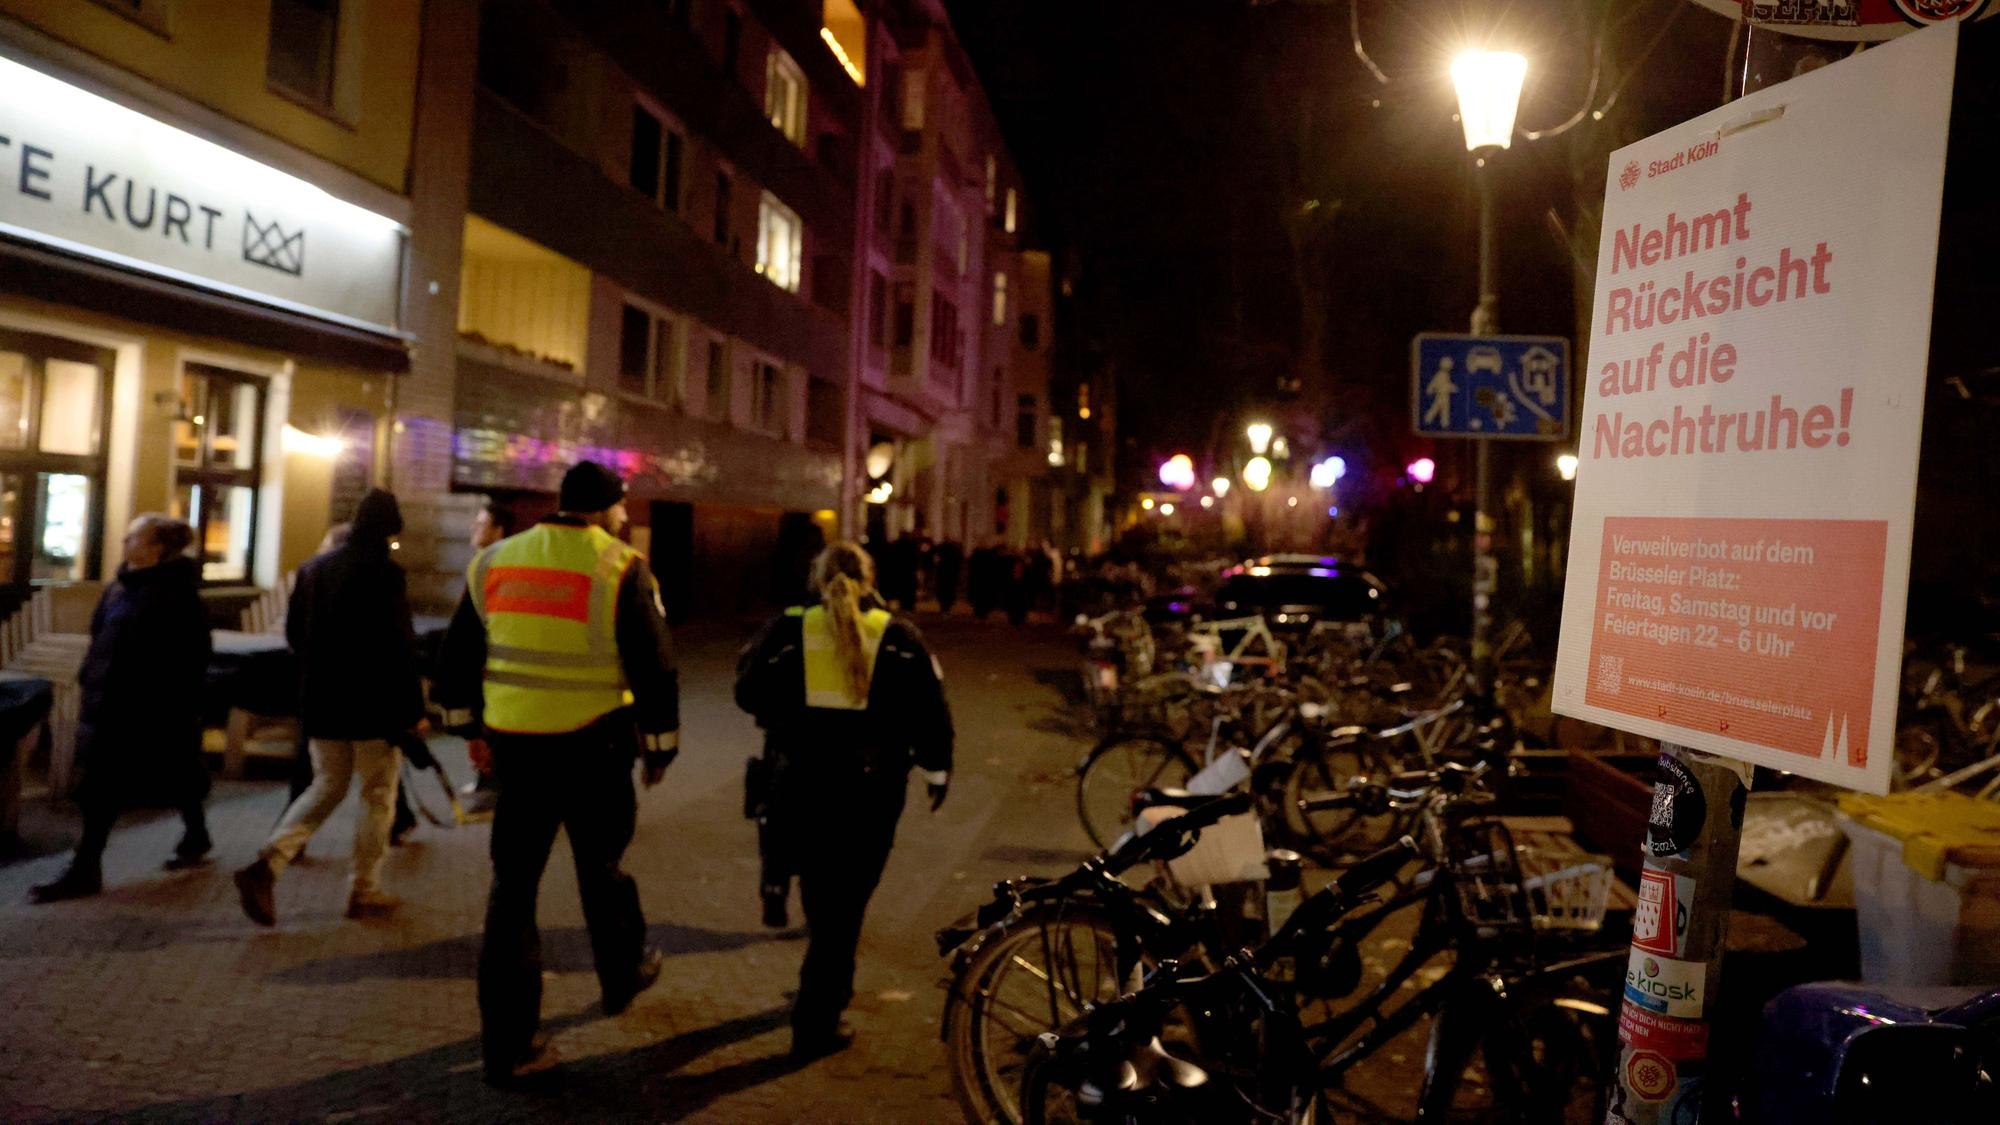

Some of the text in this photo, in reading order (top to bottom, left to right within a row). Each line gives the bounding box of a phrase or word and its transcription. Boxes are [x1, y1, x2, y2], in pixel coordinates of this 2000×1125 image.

[1648, 140, 1719, 179] Stadt Köln
[83, 164, 222, 250] KURT
[1611, 192, 1752, 275] Nehmt
[1605, 241, 1833, 336] Rücksicht
[1599, 331, 1737, 397] auf die
[1593, 387, 1854, 459] Nachtruhe!
[1611, 534, 1814, 564] Verweilverbot auf dem
[1609, 560, 1740, 591] Brüsseler Platz:
[1606, 587, 1837, 632] Freitag, Samstag und vor
[1603, 613, 1690, 645] Feiertagen
[1694, 624, 1719, 648] 22
[1738, 629, 1751, 652] 6
[1756, 633, 1795, 657] Uhr
[1628, 674, 1813, 721] www.stadt-koeln.de/bruesselerplatz
[1637, 971, 1697, 1001] kiosk
